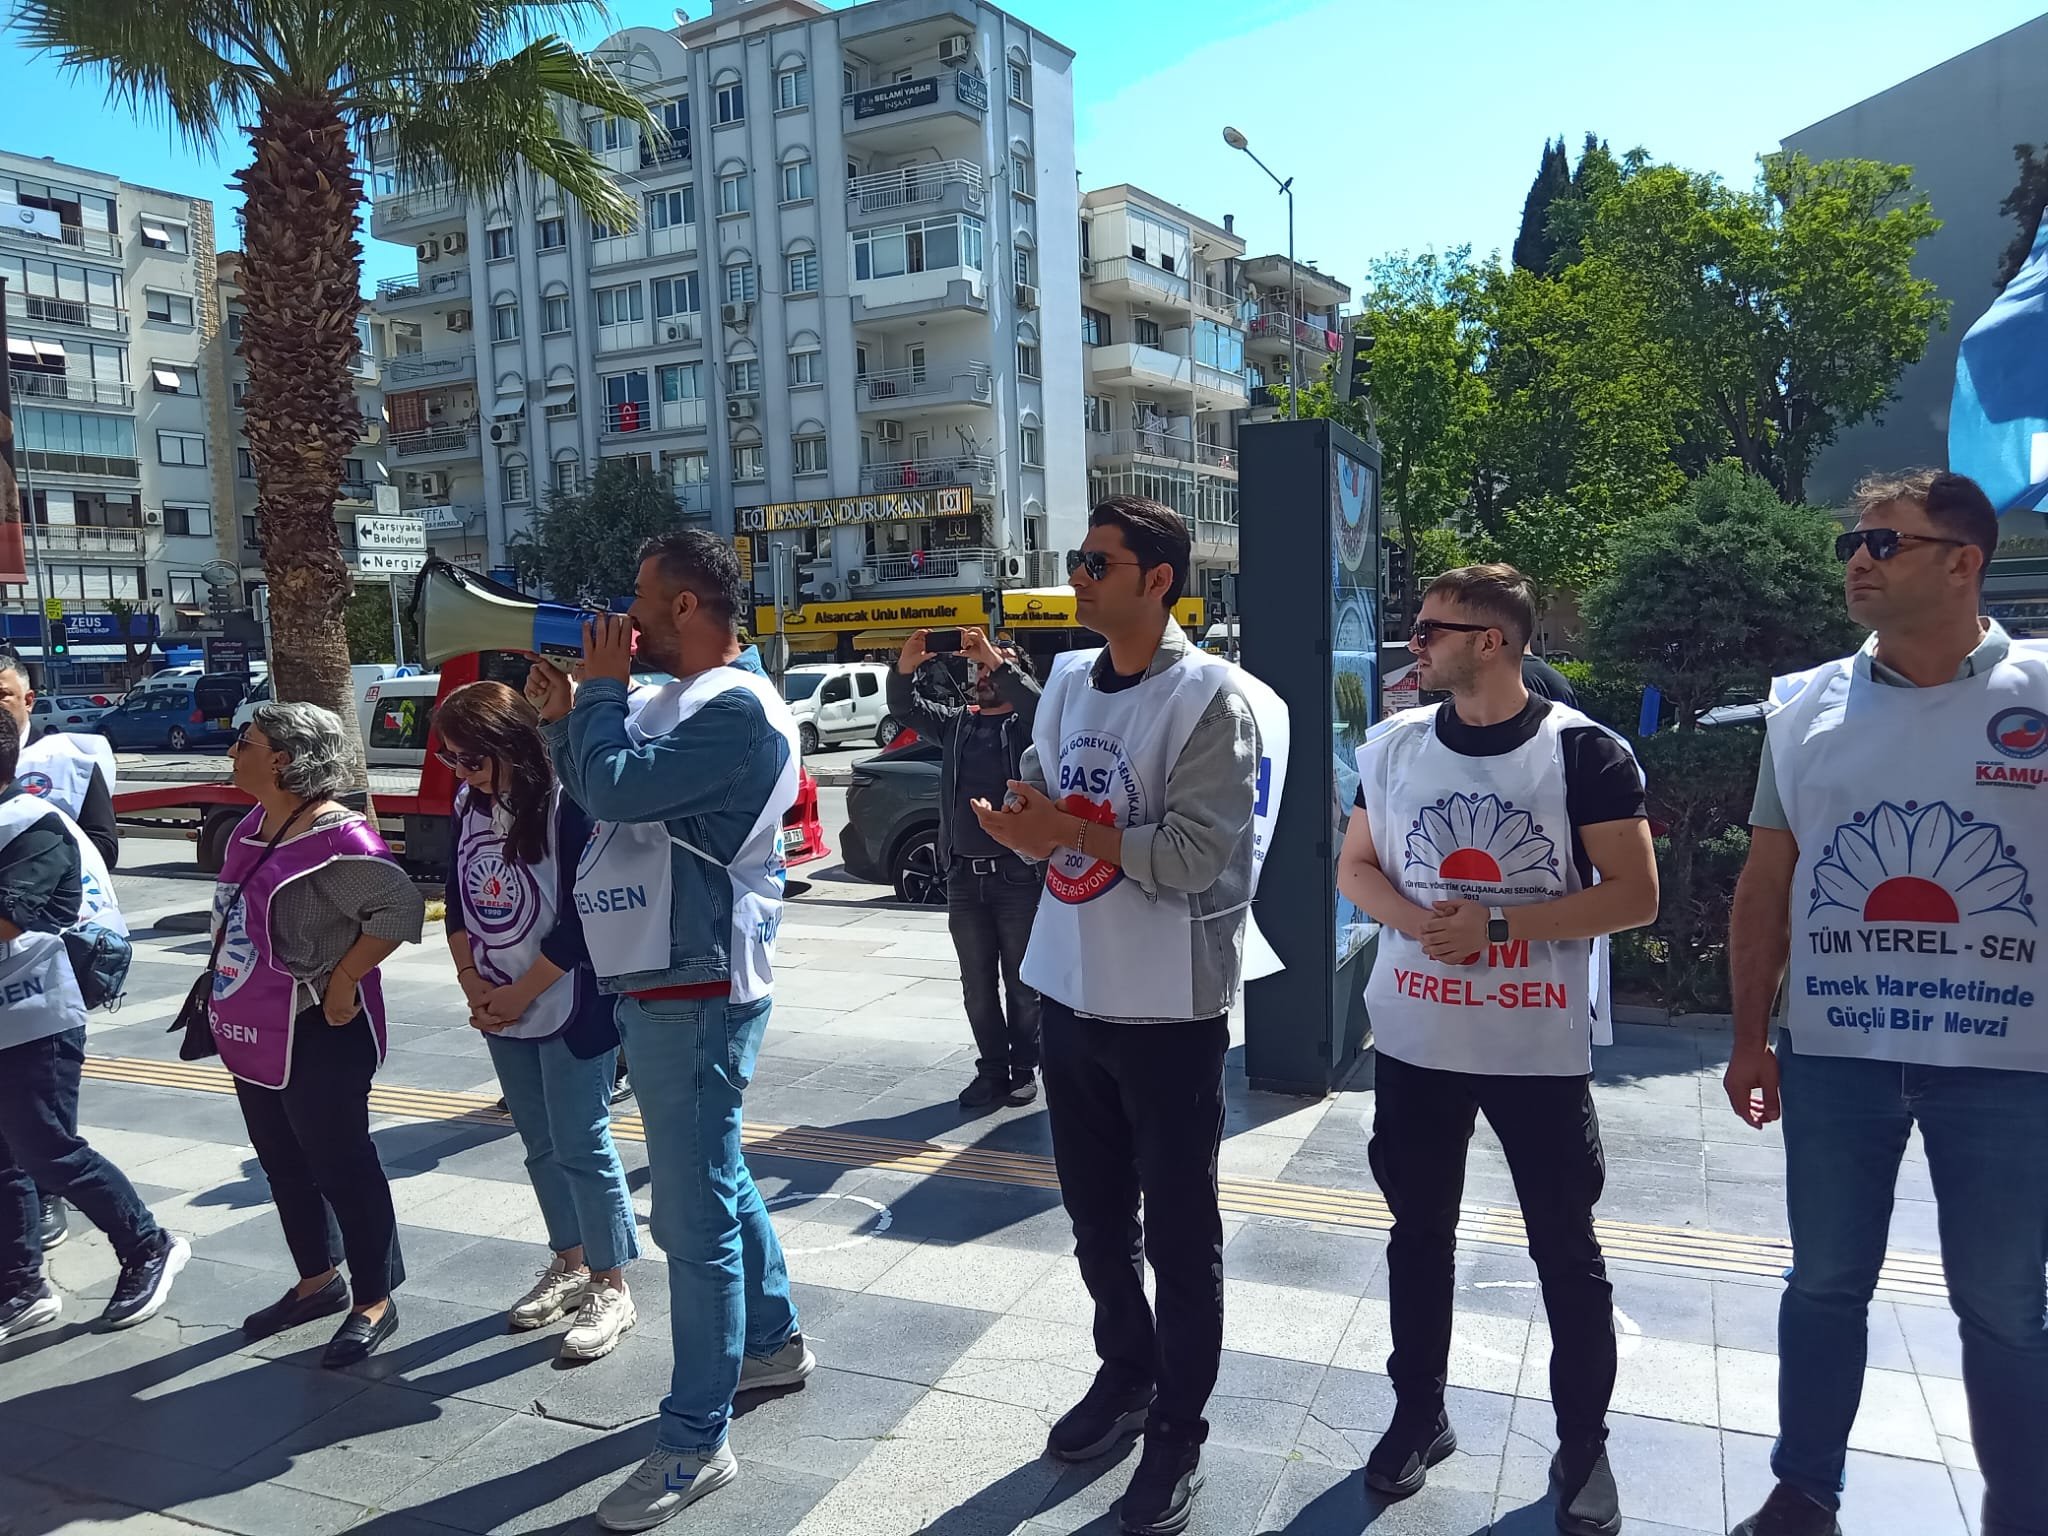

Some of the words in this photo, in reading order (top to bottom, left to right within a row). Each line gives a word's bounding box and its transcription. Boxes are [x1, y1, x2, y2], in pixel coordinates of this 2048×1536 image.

[774, 505, 836, 528] DAMLA
[840, 498, 926, 521] DURUKAN
[372, 520, 423, 533] Karşıyaka
[373, 534, 422, 546] Belediyesi
[374, 555, 422, 571] Nergiz
[70, 616, 102, 627] ZEUS
[814, 610, 868, 624] Alsancak
[871, 608, 898, 620] Unlu
[901, 605, 957, 619] Mamuller
[1809, 926, 1853, 955] TÜM
[1856, 928, 1958, 955] YEREL
[1980, 934, 2036, 963] SEN
[1393, 967, 1567, 1009] YEREL-SEN
[1805, 975, 1870, 997] Emek
[1875, 974, 2035, 1008] Hareketinde
[1827, 1006, 1886, 1034] Güçlü
[1890, 1008, 1935, 1032] Bir
[1944, 1011, 2010, 1038] Mevzi
